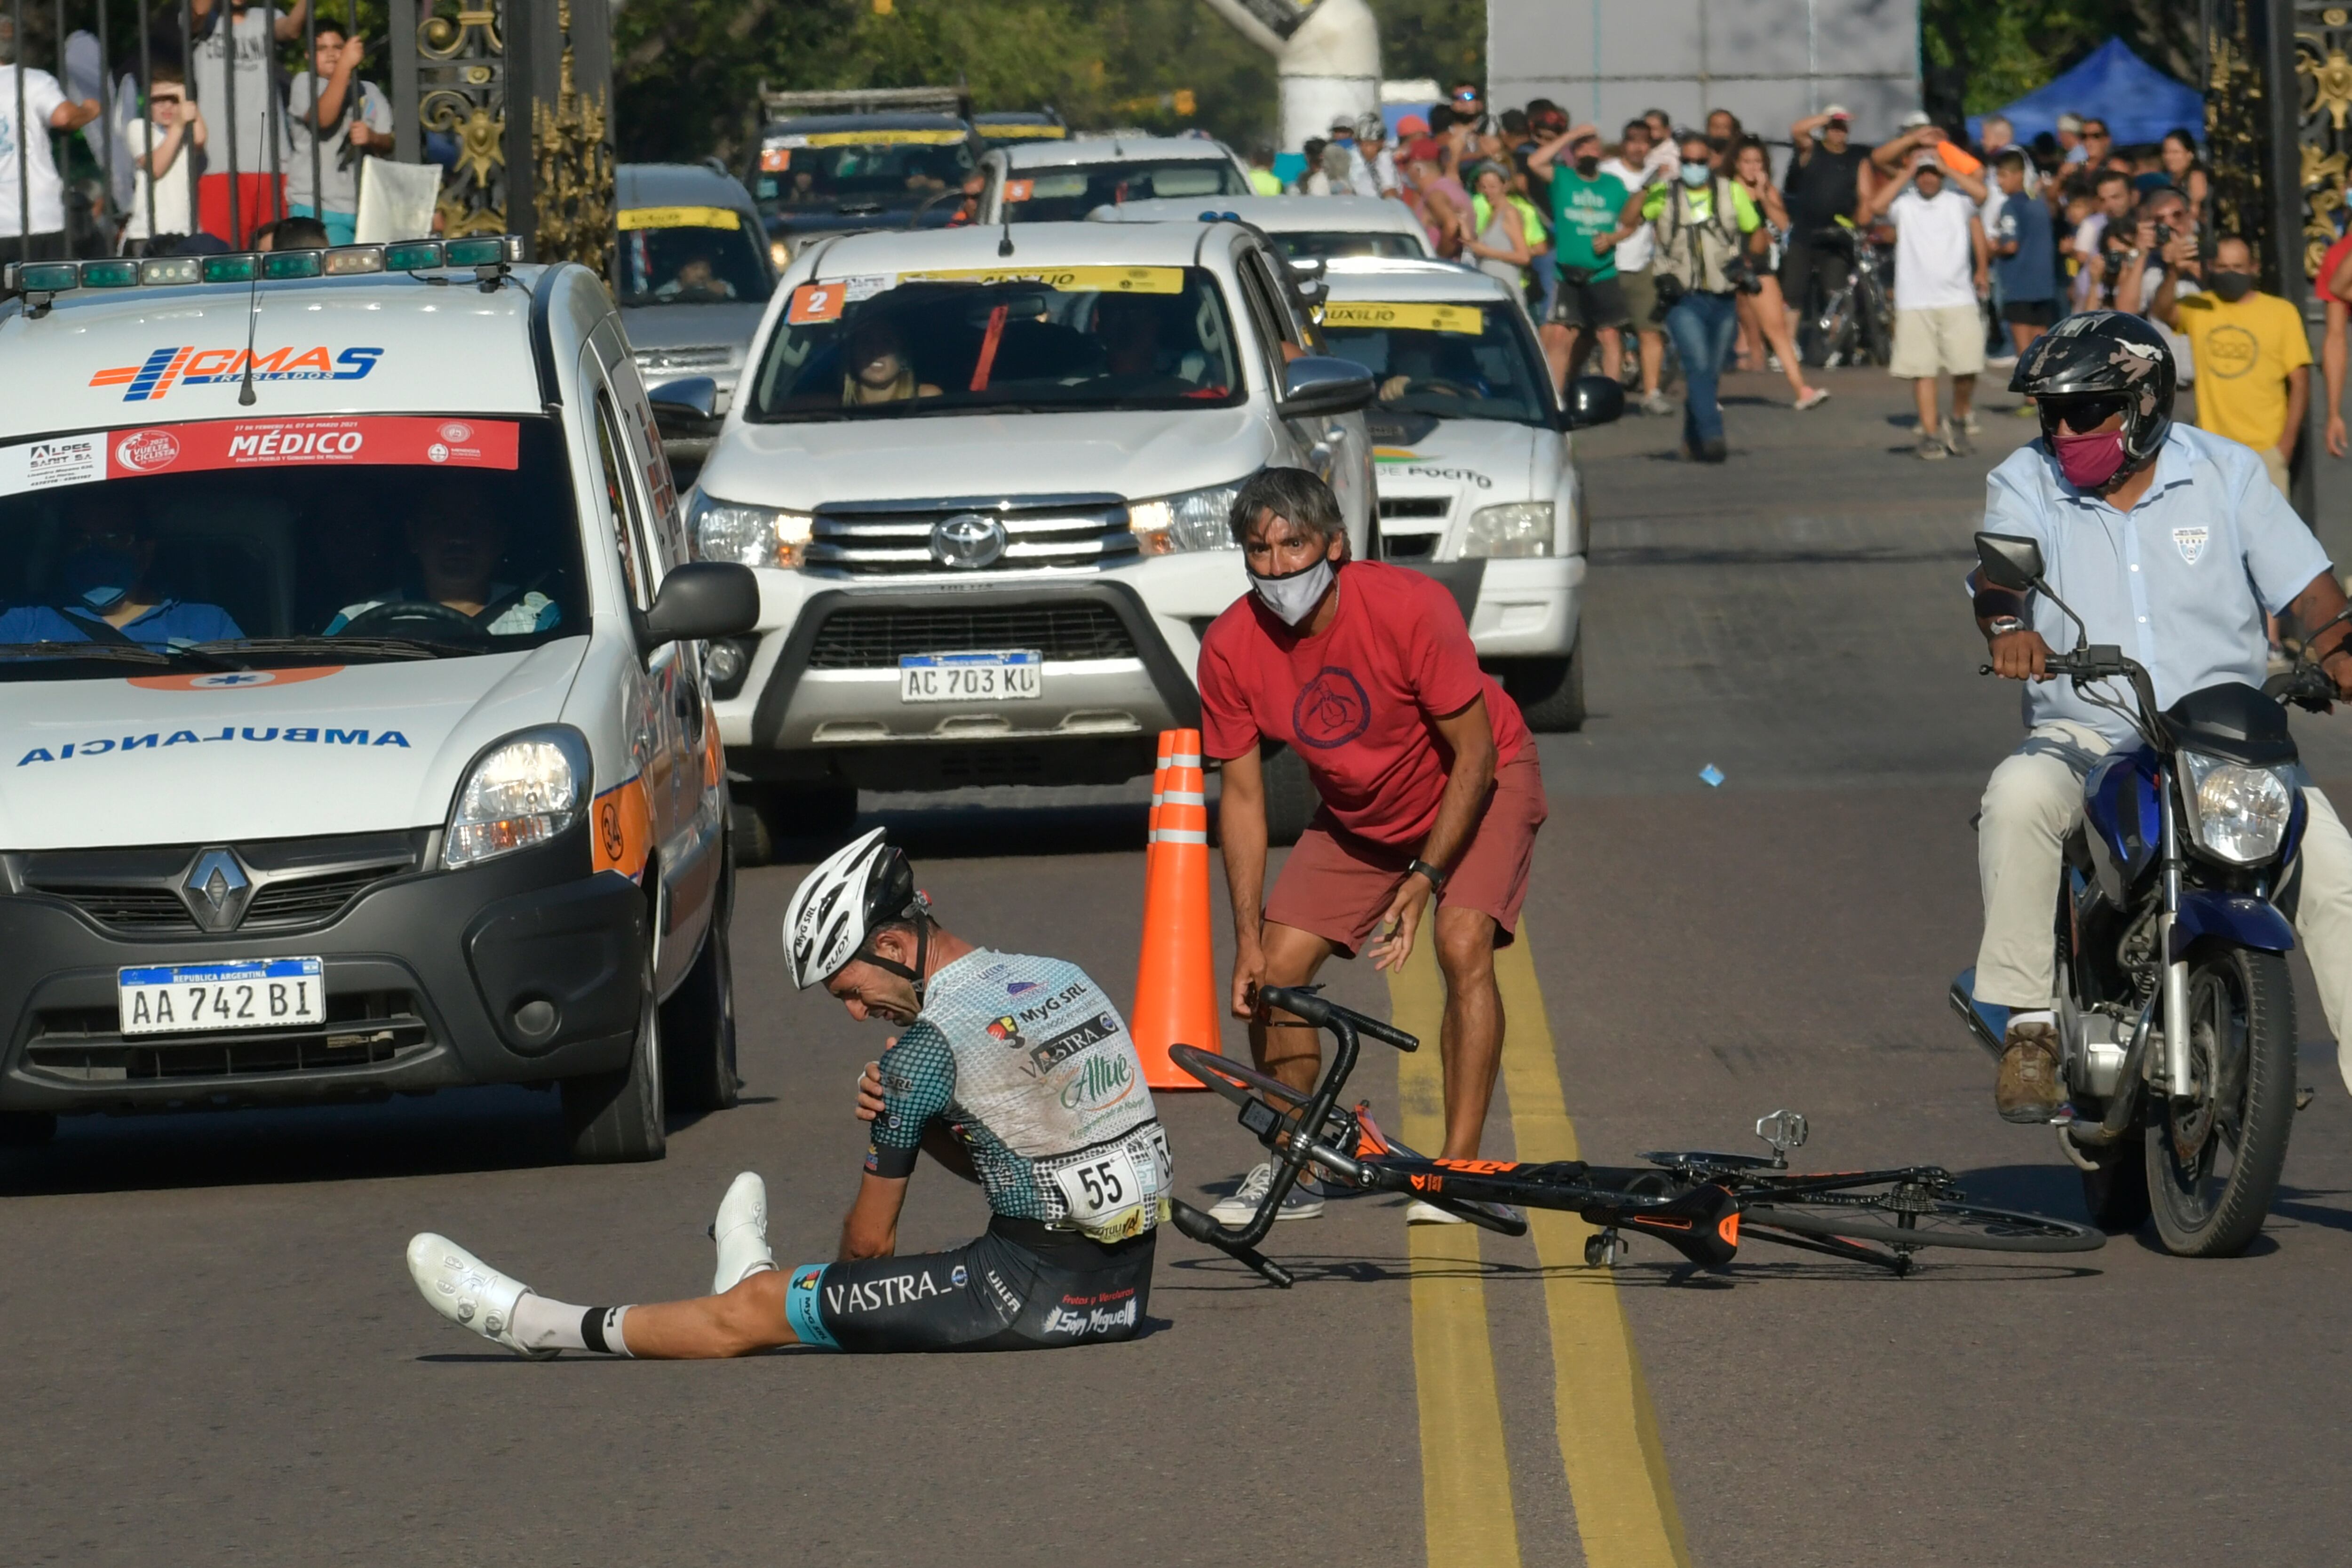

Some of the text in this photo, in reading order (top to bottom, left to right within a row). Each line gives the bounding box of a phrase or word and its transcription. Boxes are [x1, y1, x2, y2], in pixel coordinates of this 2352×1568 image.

[807, 291, 828, 313] 2
[208, 372, 335, 383] TRASLADOS
[134, 443, 169, 455] VUELTA
[134, 448, 175, 462] CICLISTA
[228, 429, 363, 457] MÉDICO
[1408, 466, 1492, 489] POCITO
[909, 671, 938, 696] AC
[947, 669, 994, 693] 703
[604, 814, 621, 850] 34
[795, 906, 817, 948] MyG SRL
[825, 929, 850, 974] RUDY
[173, 970, 267, 983] REPUBLICA ARGENTINA
[133, 981, 311, 1025] AA 742 BI
[1019, 997, 1061, 1023] MyG
[1059, 983, 1088, 1003] SRL
[887, 1075, 914, 1091] SRL
[1077, 1161, 1123, 1210] 55
[988, 1270, 1021, 1313] ULLER
[1062, 1287, 1135, 1306] Frutas y Verduras
[803, 1296, 815, 1324] MyG
[813, 1325, 828, 1340] SRL
[1086, 1300, 1130, 1333] Miguel
